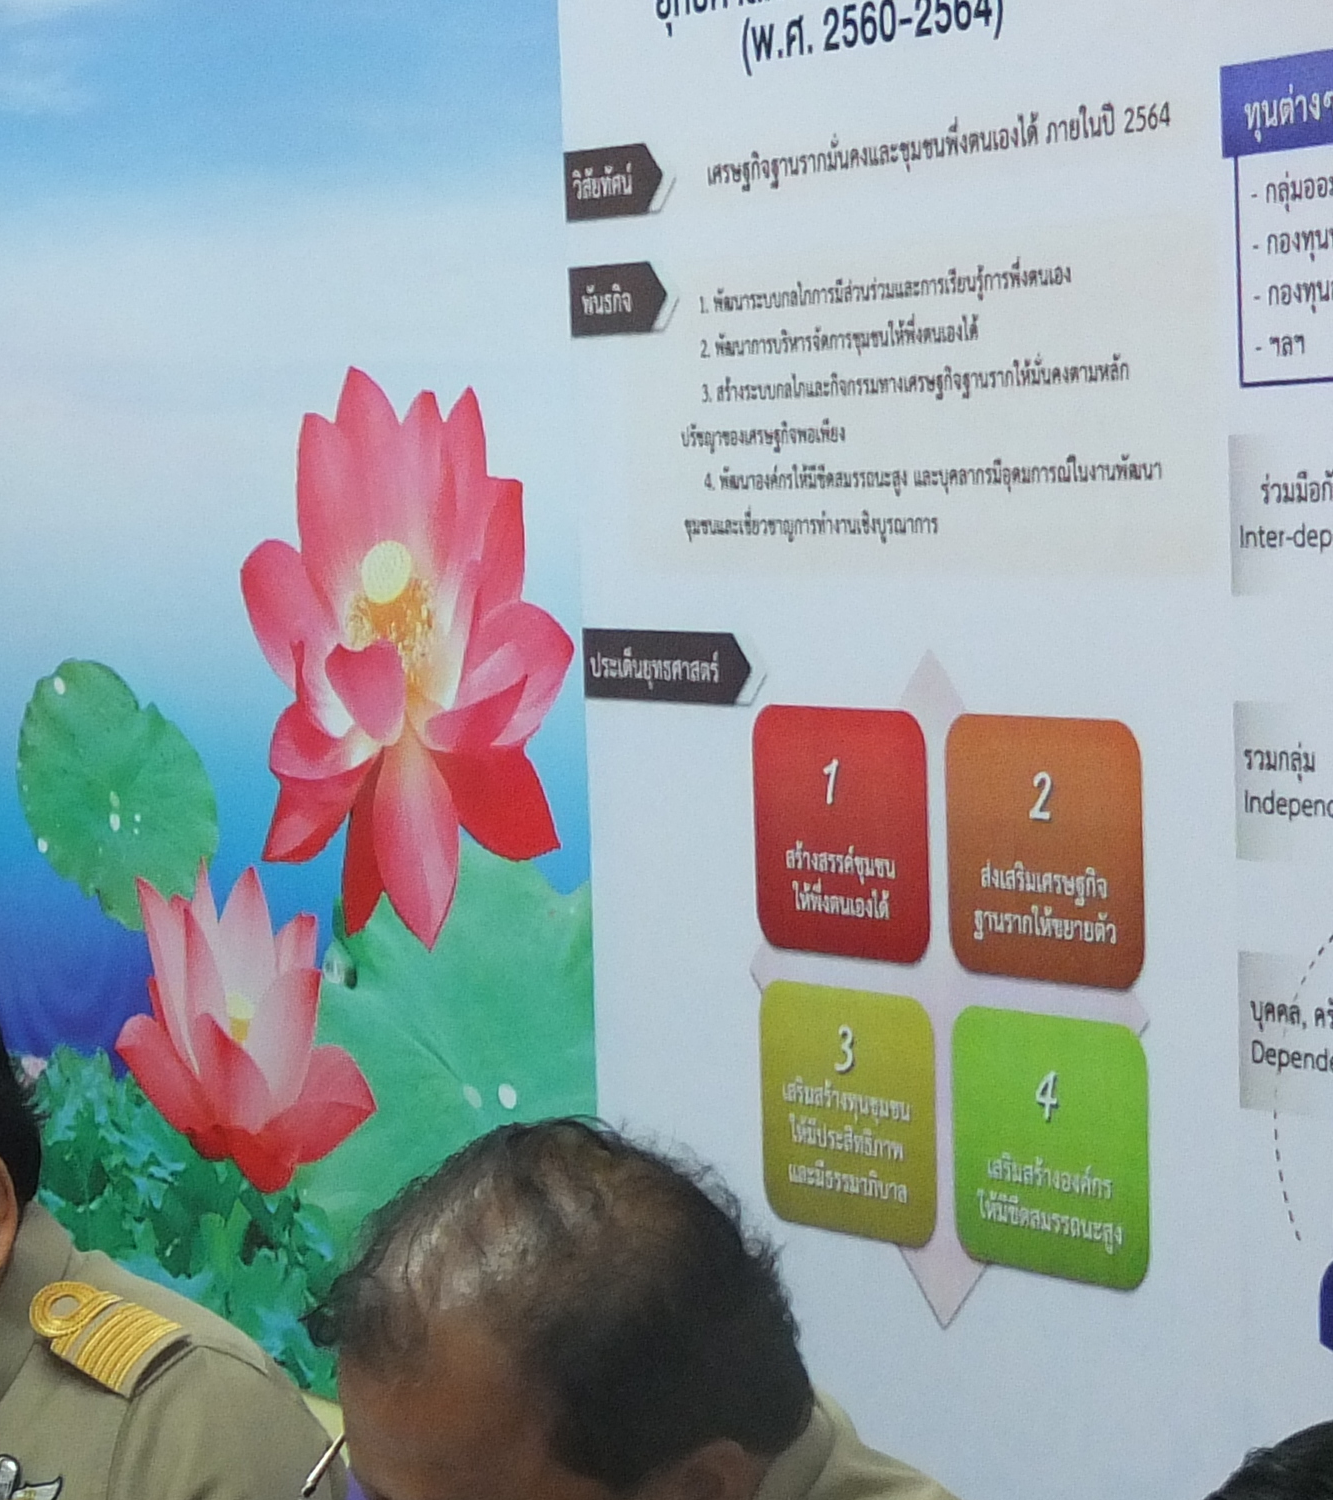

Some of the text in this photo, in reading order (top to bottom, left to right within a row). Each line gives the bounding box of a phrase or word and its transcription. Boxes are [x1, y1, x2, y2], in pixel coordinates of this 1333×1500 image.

[741, 17, 814, 76] (พ.ศ.
[1044, 102, 1116, 145] ภายในปี
[1123, 101, 1171, 134] 2564
[571, 161, 634, 200] วิสัยทัศน์
[1267, 227, 1333, 262] กองทุน
[581, 283, 633, 316] พันธกิจ
[699, 294, 710, 314] 1.
[1268, 279, 1333, 314] กองทุน
[700, 339, 711, 359] 2.
[1268, 333, 1305, 357] ฯลฯ
[701, 383, 713, 403] 3.
[704, 472, 716, 491] 4.
[589, 646, 721, 691] ประเด็นยุทธศาสตร์
[821, 757, 841, 806] 1
[1243, 741, 1316, 783] รวมกลุ่ม
[1028, 770, 1053, 821] 2
[785, 840, 897, 886] สร้างสรรค์ชุมชน
[980, 858, 1109, 907] ส่งเสริมเศรษฐกิจ
[791, 877, 891, 920] ให้พึ่งตนเองได้
[972, 904, 1118, 945] ฐานรากให้ขยายตัว
[833, 1024, 856, 1074] 3
[1034, 1069, 1059, 1124] 4
